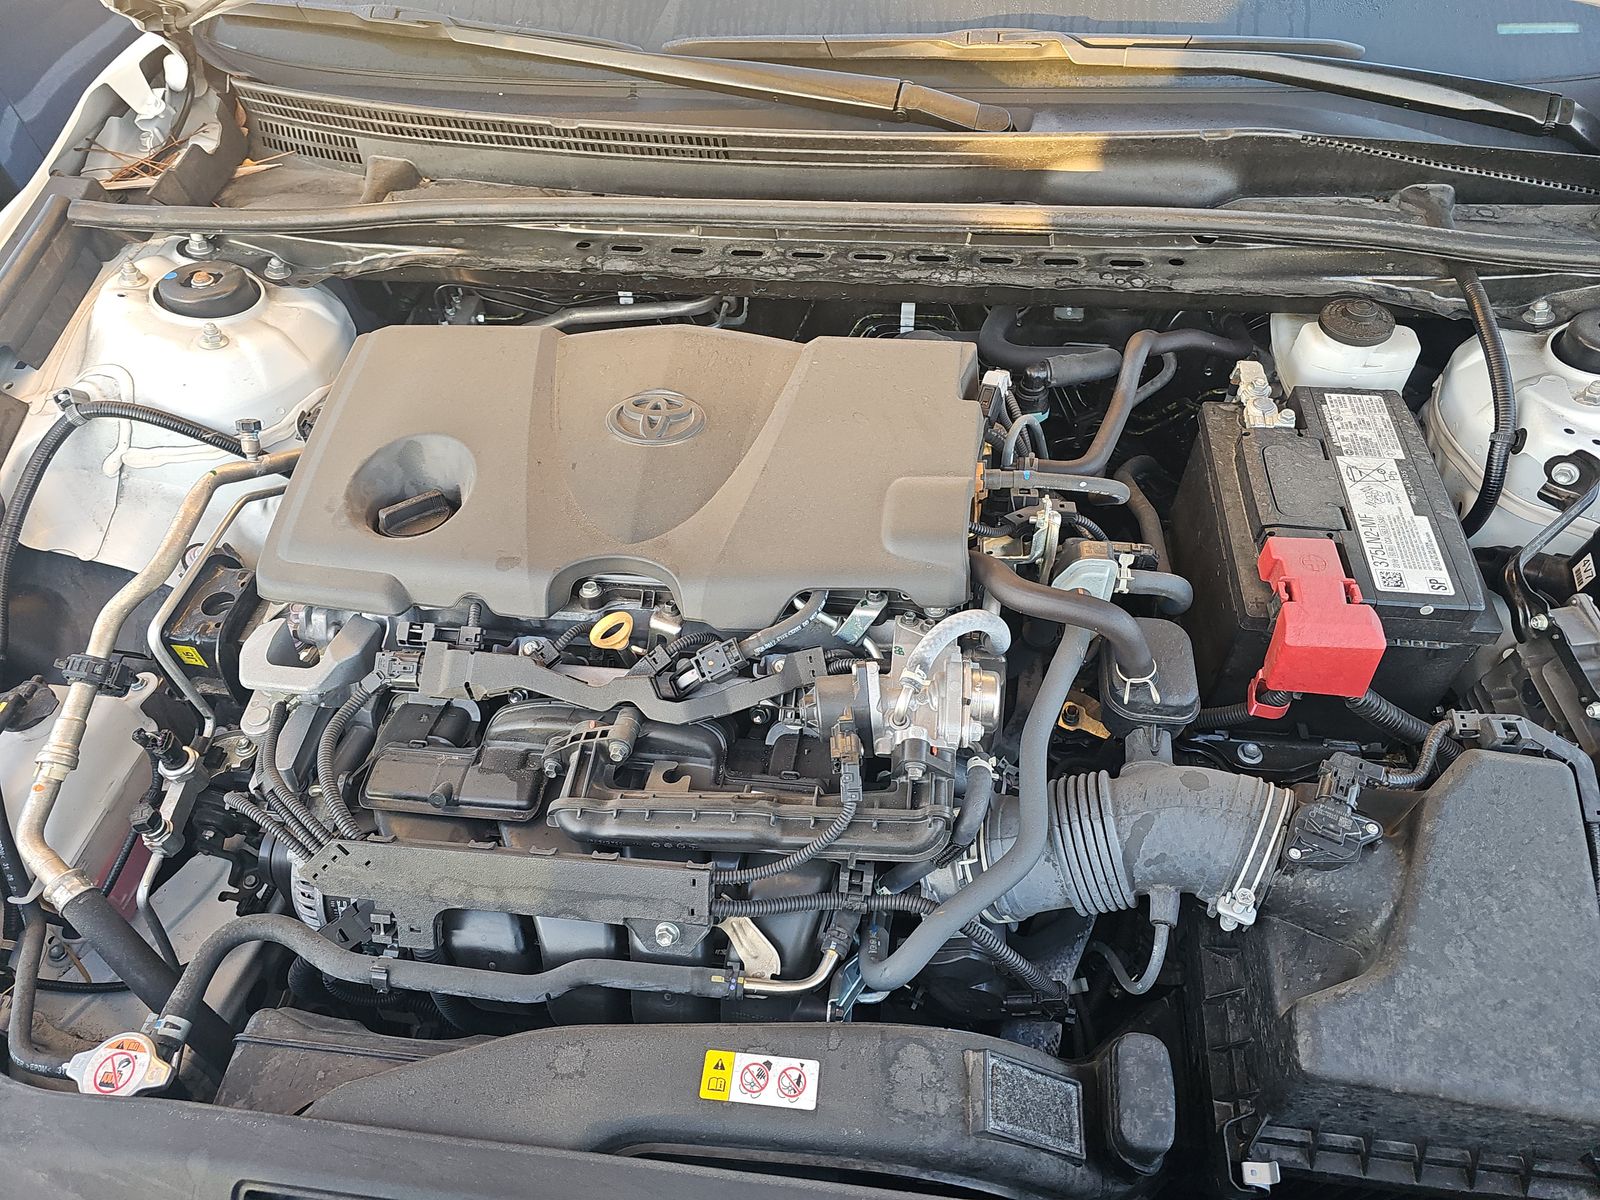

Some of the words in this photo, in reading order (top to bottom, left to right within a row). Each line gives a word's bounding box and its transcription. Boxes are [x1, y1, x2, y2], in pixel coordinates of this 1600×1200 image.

[1388, 470, 1398, 480] Pb
[1360, 513, 1389, 567] 375LN2-MF
[1583, 559, 1594, 579] 4V7
[1430, 579, 1447, 591] SP
